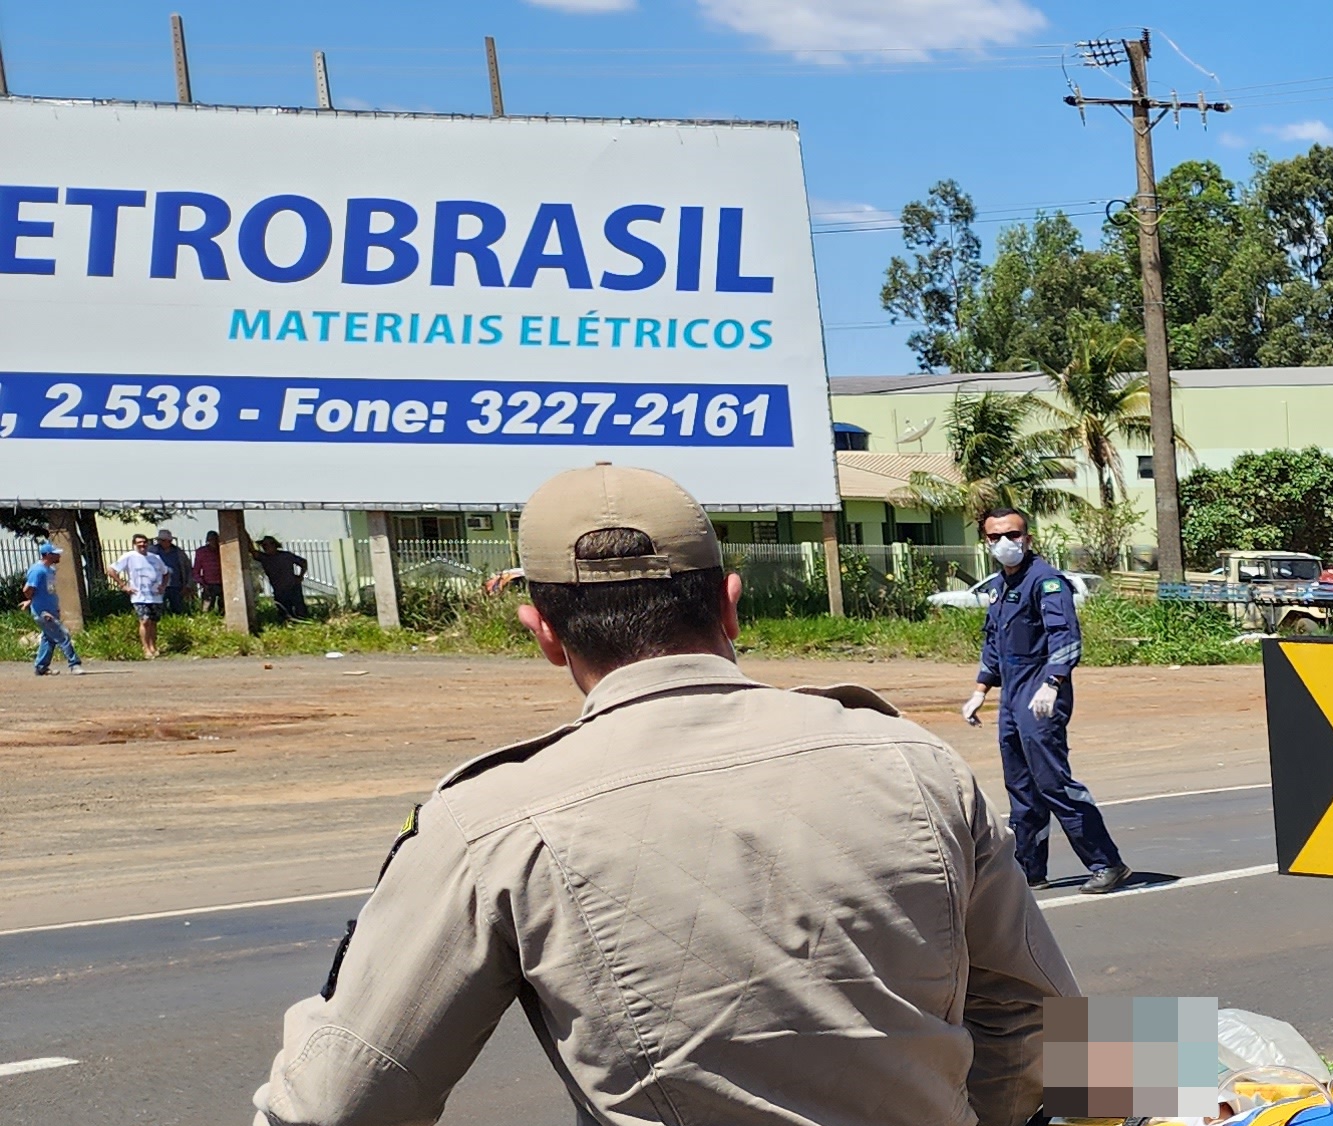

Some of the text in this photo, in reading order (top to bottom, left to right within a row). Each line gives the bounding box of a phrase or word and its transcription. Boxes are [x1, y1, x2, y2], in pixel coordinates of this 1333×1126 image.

[228, 308, 774, 349] MATERIAIS ELÉTRICOS
[40, 382, 221, 430] 2.538
[279, 388, 448, 433] Fone:
[466, 390, 770, 437] 3227-2161
